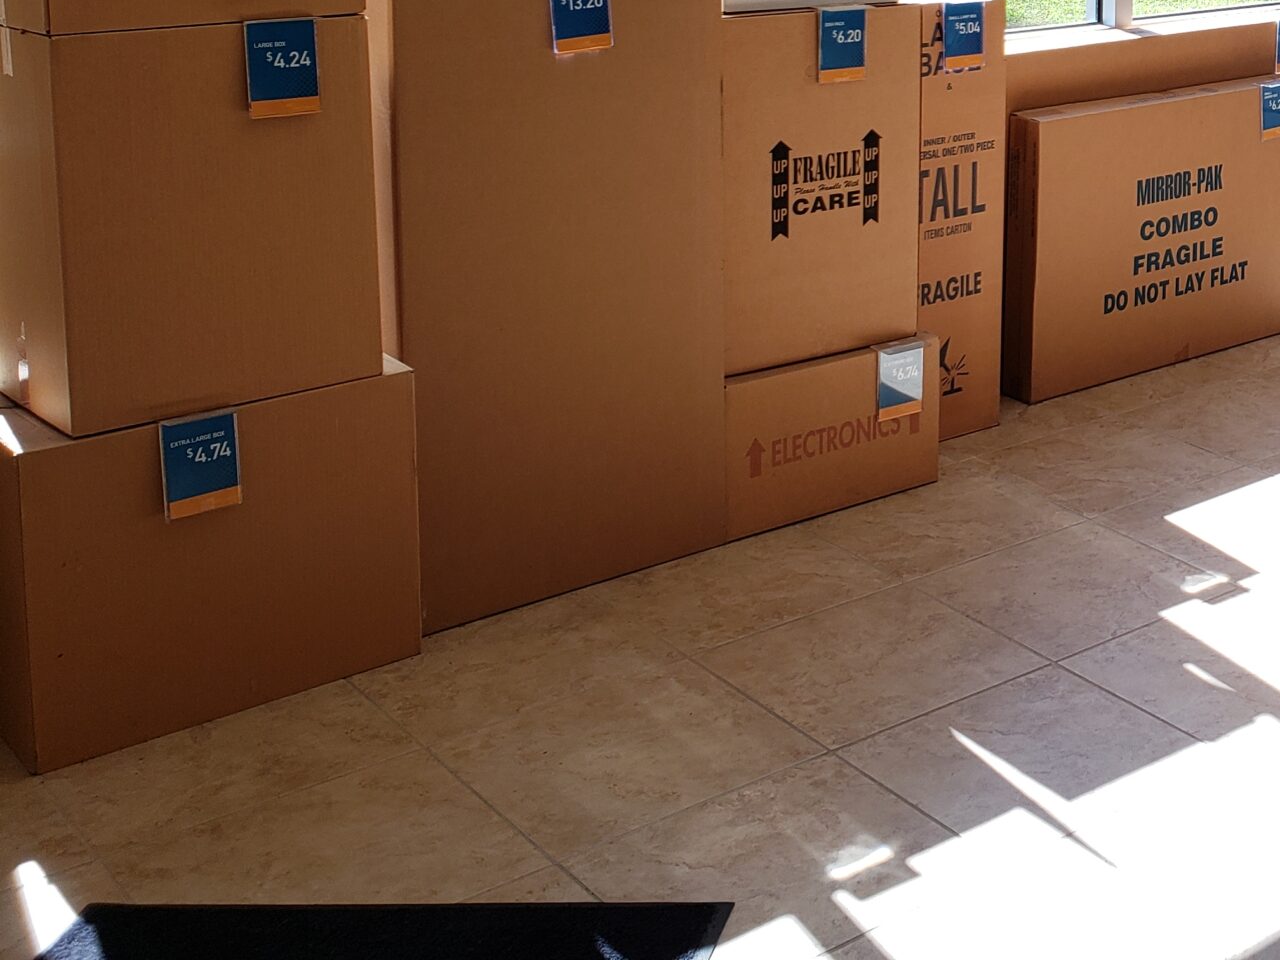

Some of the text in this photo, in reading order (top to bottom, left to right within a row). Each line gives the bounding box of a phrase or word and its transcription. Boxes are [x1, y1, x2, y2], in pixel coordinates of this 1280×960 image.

[832, 29, 862, 43] $6.20
[955, 21, 980, 34] $5.04
[253, 41, 273, 49] LARGE
[266, 50, 311, 68] $4.24
[865, 147, 878, 161] UP
[920, 139, 995, 160] ERSAL ONE/TWO PIECE
[773, 159, 787, 174] UP
[792, 149, 861, 185] FRAGILE
[864, 171, 878, 185] UP
[1136, 164, 1223, 206] MIRROR-PAK
[773, 183, 787, 198] UP
[792, 190, 861, 215] CARE
[864, 194, 878, 208] UP
[773, 208, 787, 223] UP
[1140, 206, 1218, 240] COMBO
[923, 222, 972, 240] ITEMS CARTON
[1133, 236, 1224, 275] FRAGILE
[919, 271, 982, 306] RAGILE
[1103, 260, 1248, 314] DO NOT LAY FLAT
[892, 365, 919, 380] $6.74
[170, 430, 225, 448] EXTRA LARGE BOX
[771, 414, 900, 467] ELECTRONICS
[186, 440, 232, 462] $4.74
